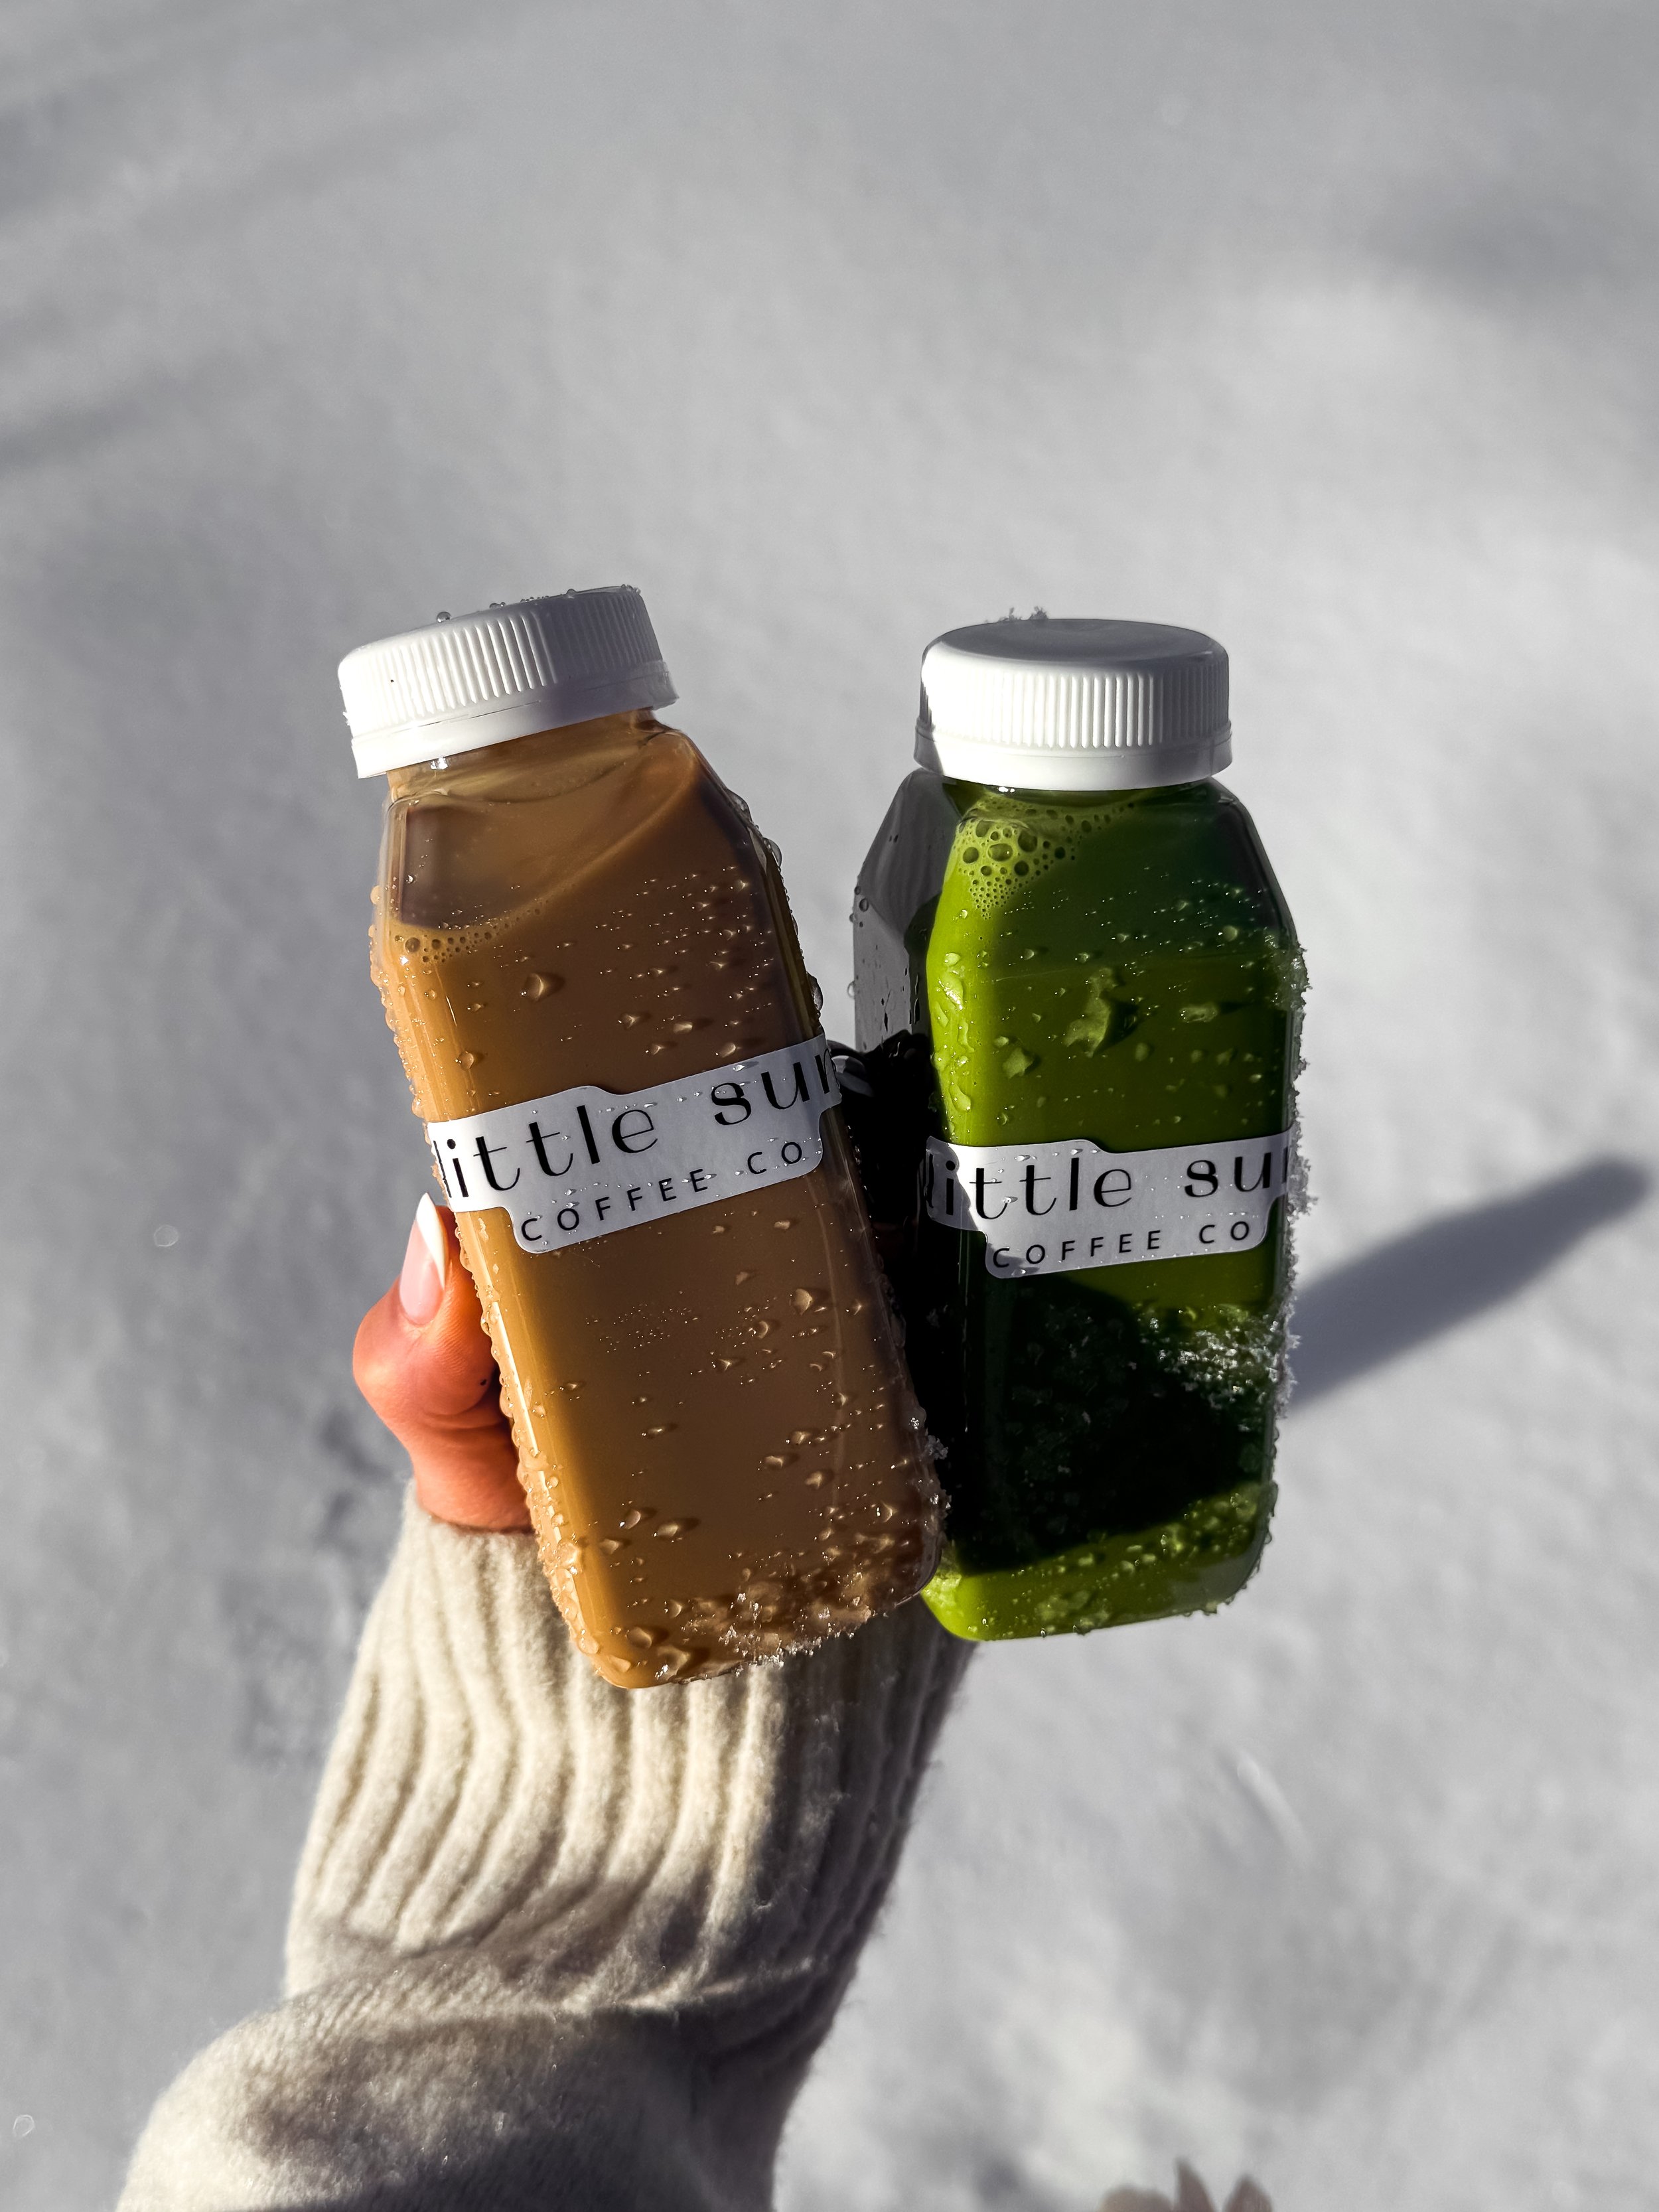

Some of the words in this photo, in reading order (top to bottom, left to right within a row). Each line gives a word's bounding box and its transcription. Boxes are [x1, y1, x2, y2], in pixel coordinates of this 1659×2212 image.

[433, 1104, 658, 1199] little
[926, 1153, 1132, 1220] little
[1185, 1146, 1288, 1197] su
[521, 1169, 709, 1242] COFFEE
[993, 1230, 1161, 1268] COFFEE
[1198, 1221, 1250, 1244] CO
